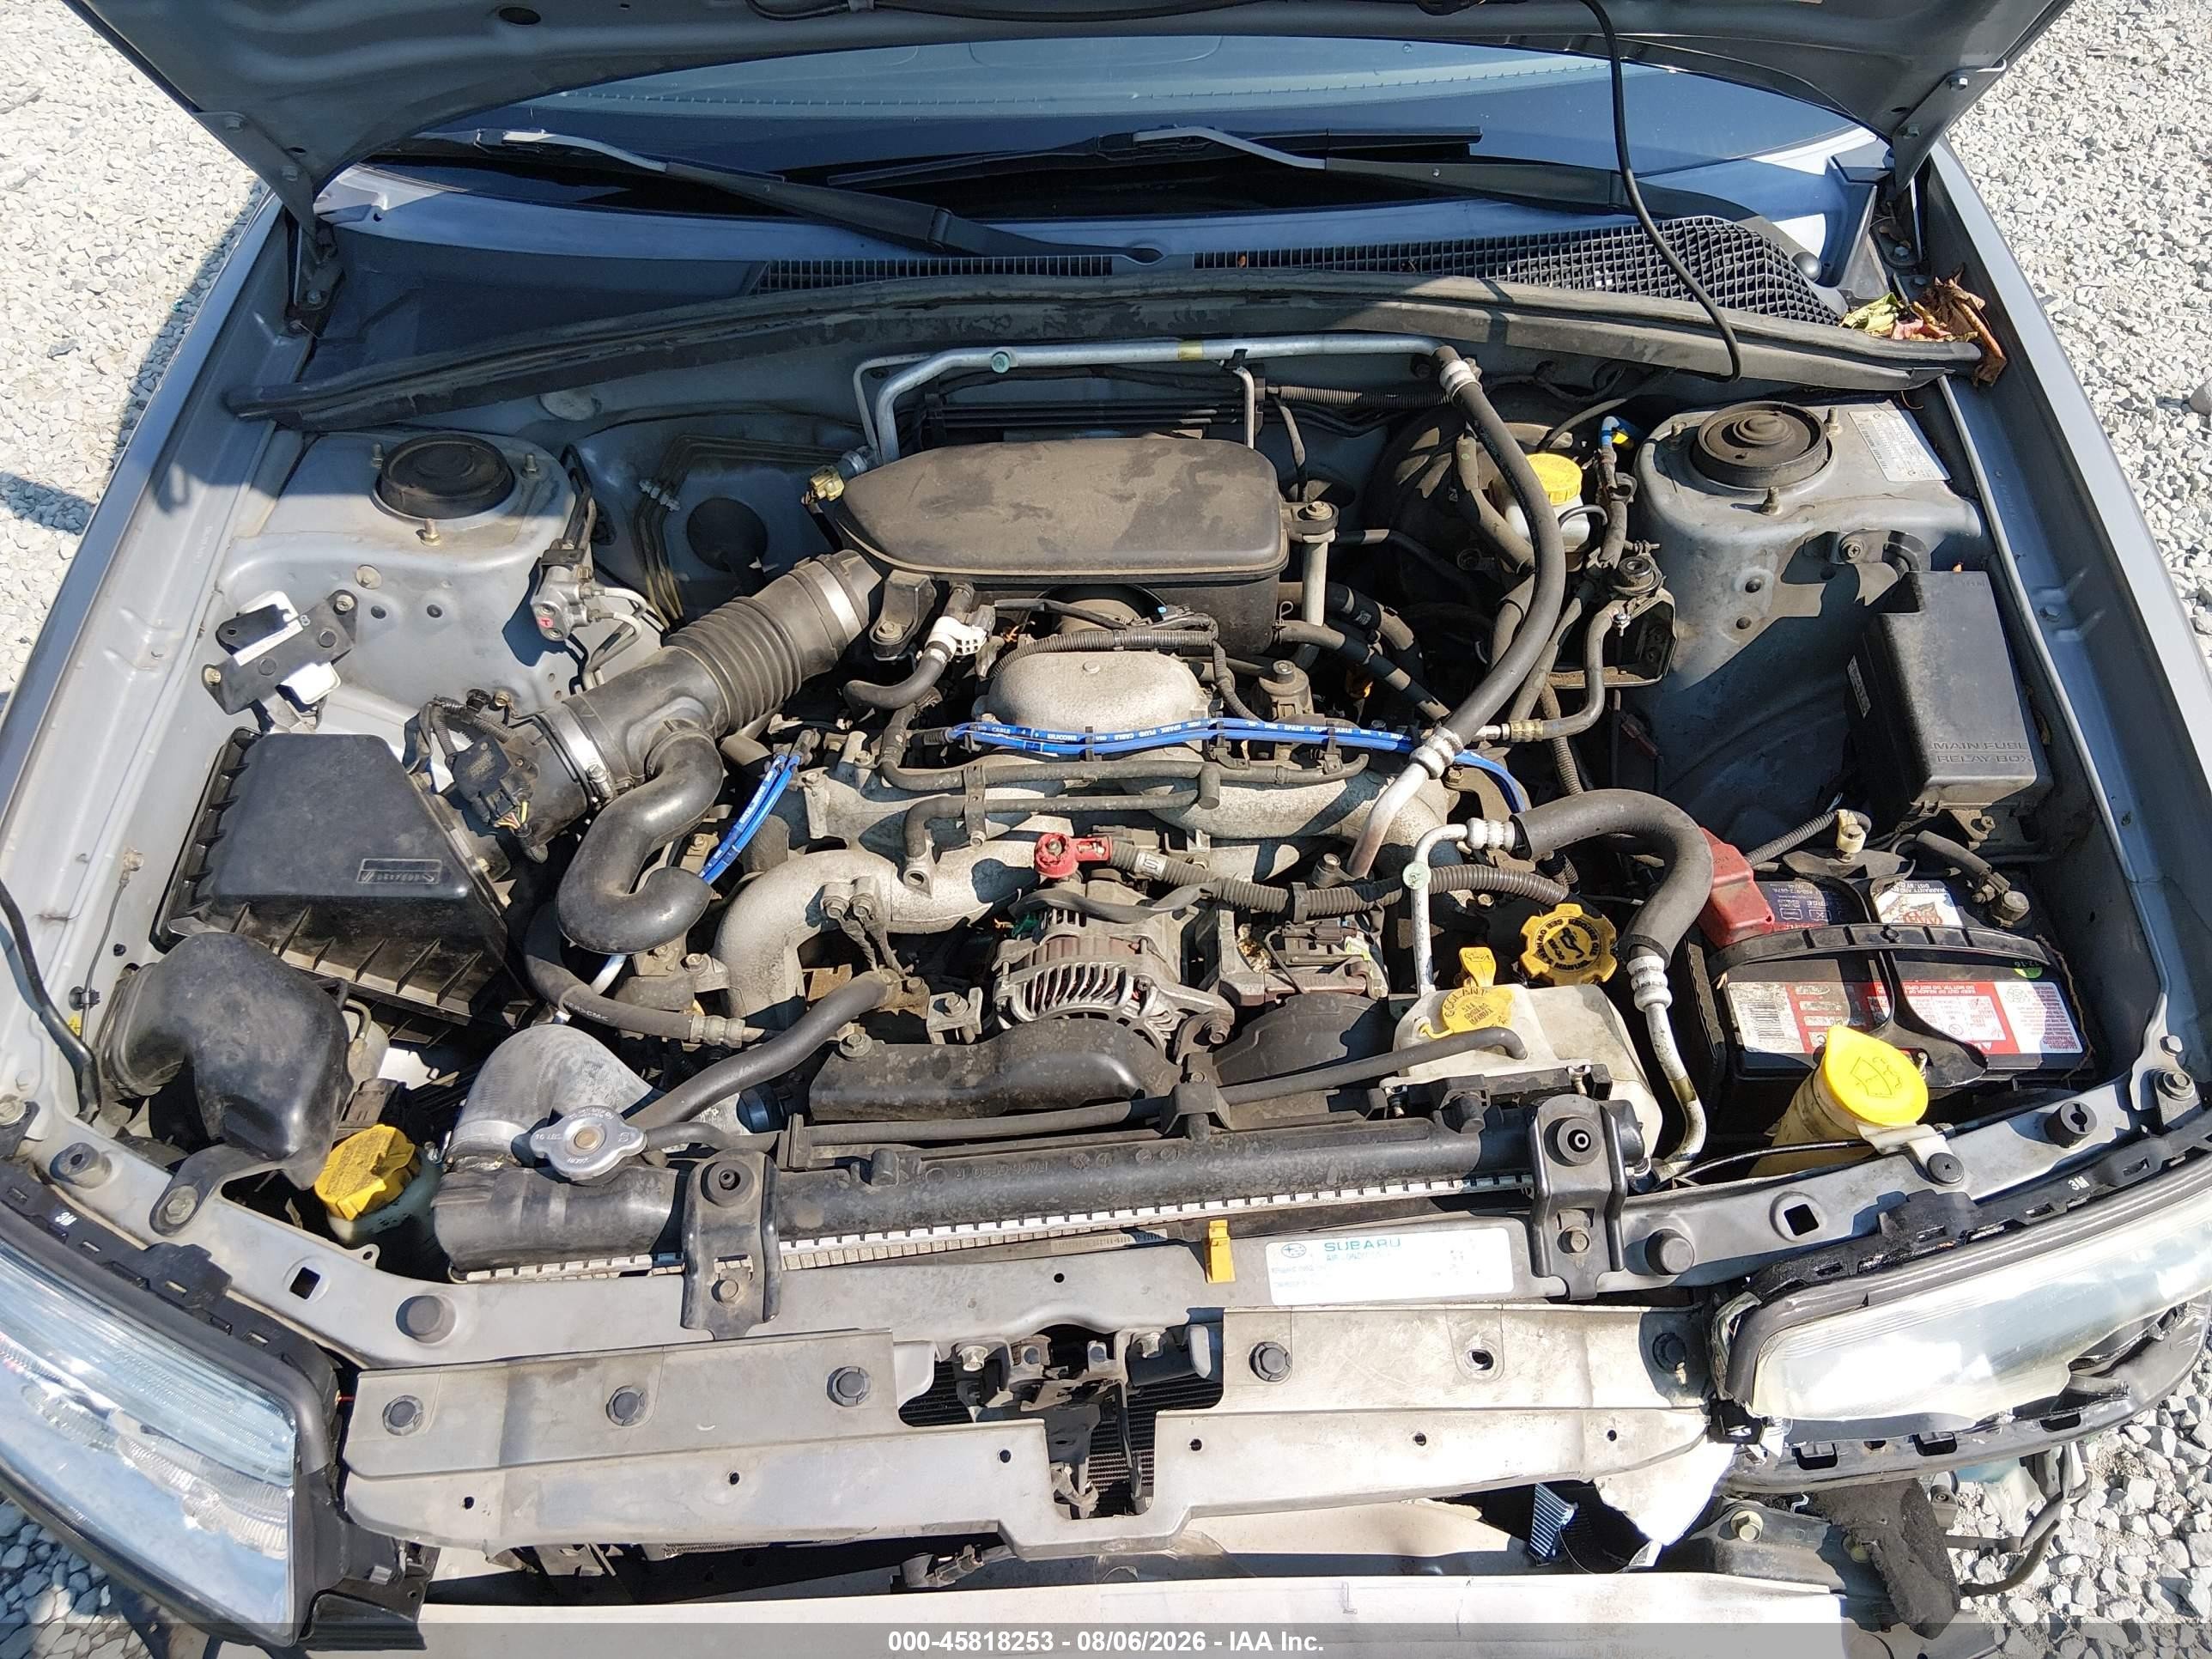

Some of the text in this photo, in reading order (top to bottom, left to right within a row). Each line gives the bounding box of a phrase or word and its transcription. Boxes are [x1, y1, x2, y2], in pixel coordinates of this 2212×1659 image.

[1139, 729, 1157, 738] PLUG
[1160, 725, 1182, 734] SPARK
[1546, 919, 1564, 929] SEE
[1443, 988, 1488, 1018] COOLANT
[2068, 1176, 2090, 1191] 3M
[55, 1212, 77, 1226] 3M
[1324, 1237, 1401, 1253] SUBARU
